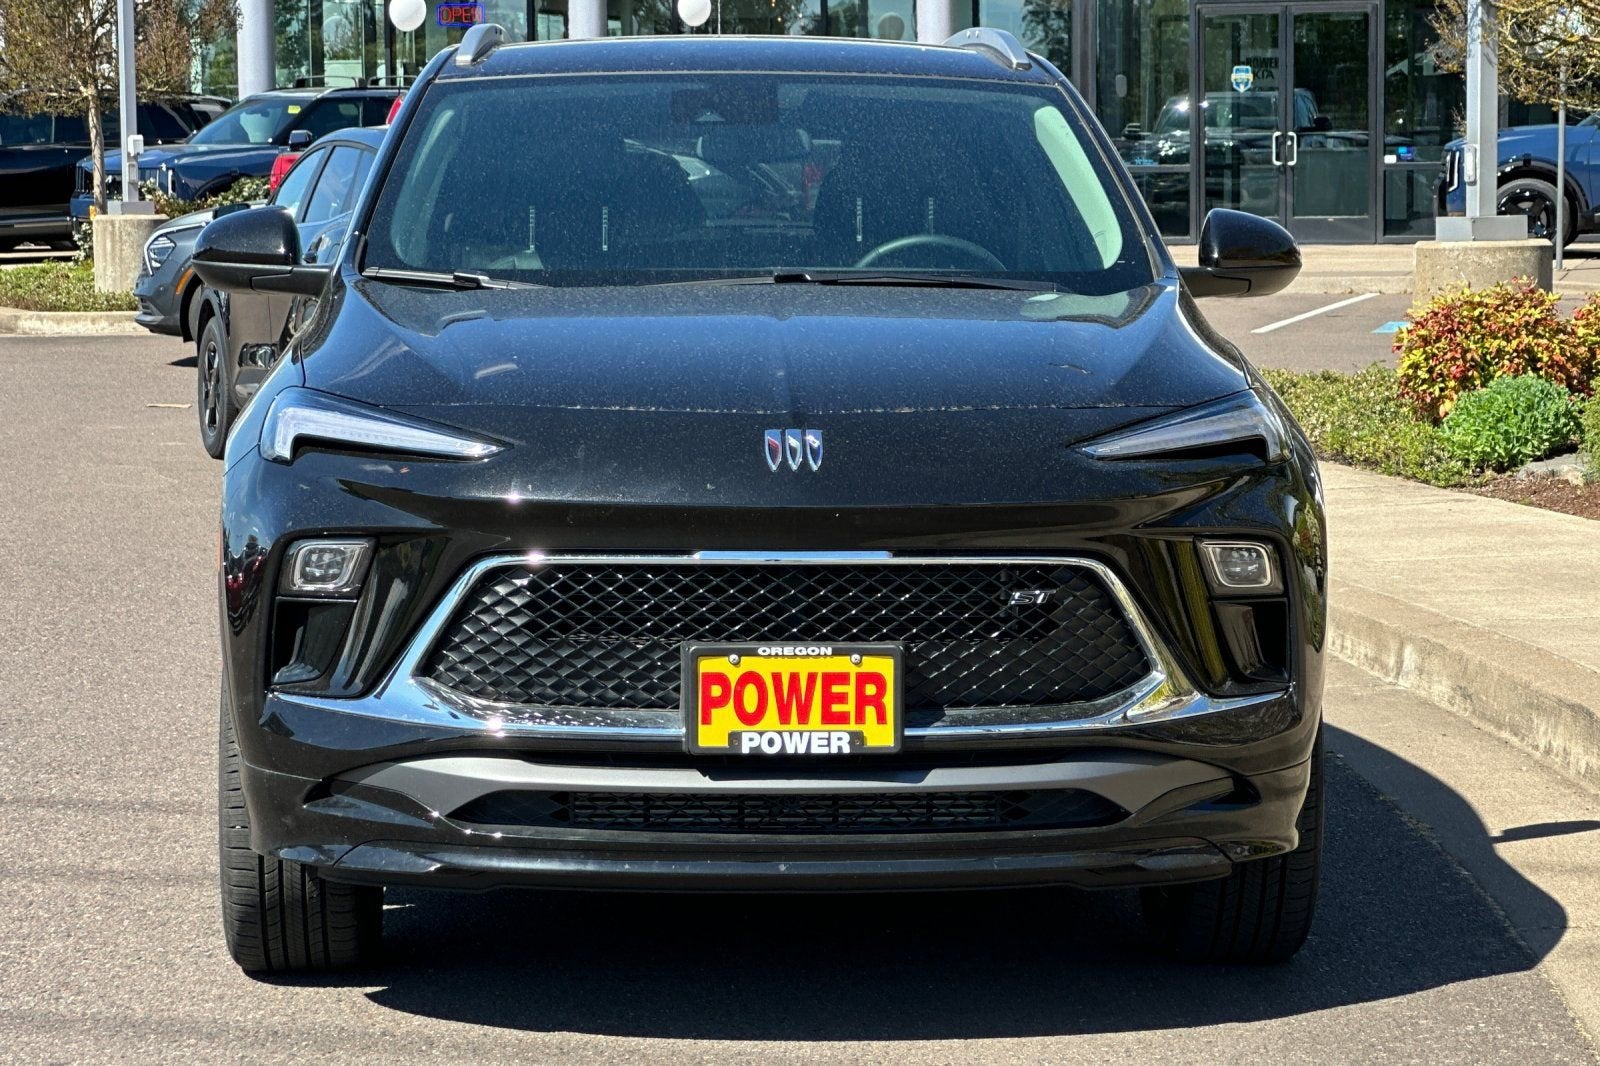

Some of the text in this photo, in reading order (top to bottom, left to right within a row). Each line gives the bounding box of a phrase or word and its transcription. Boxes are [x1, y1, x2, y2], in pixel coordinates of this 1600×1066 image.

[441, 7, 482, 23] OPEN
[1009, 590, 1056, 605] ST
[757, 646, 833, 656] OREGON
[700, 670, 888, 727] POWER
[741, 732, 851, 754] POWER
